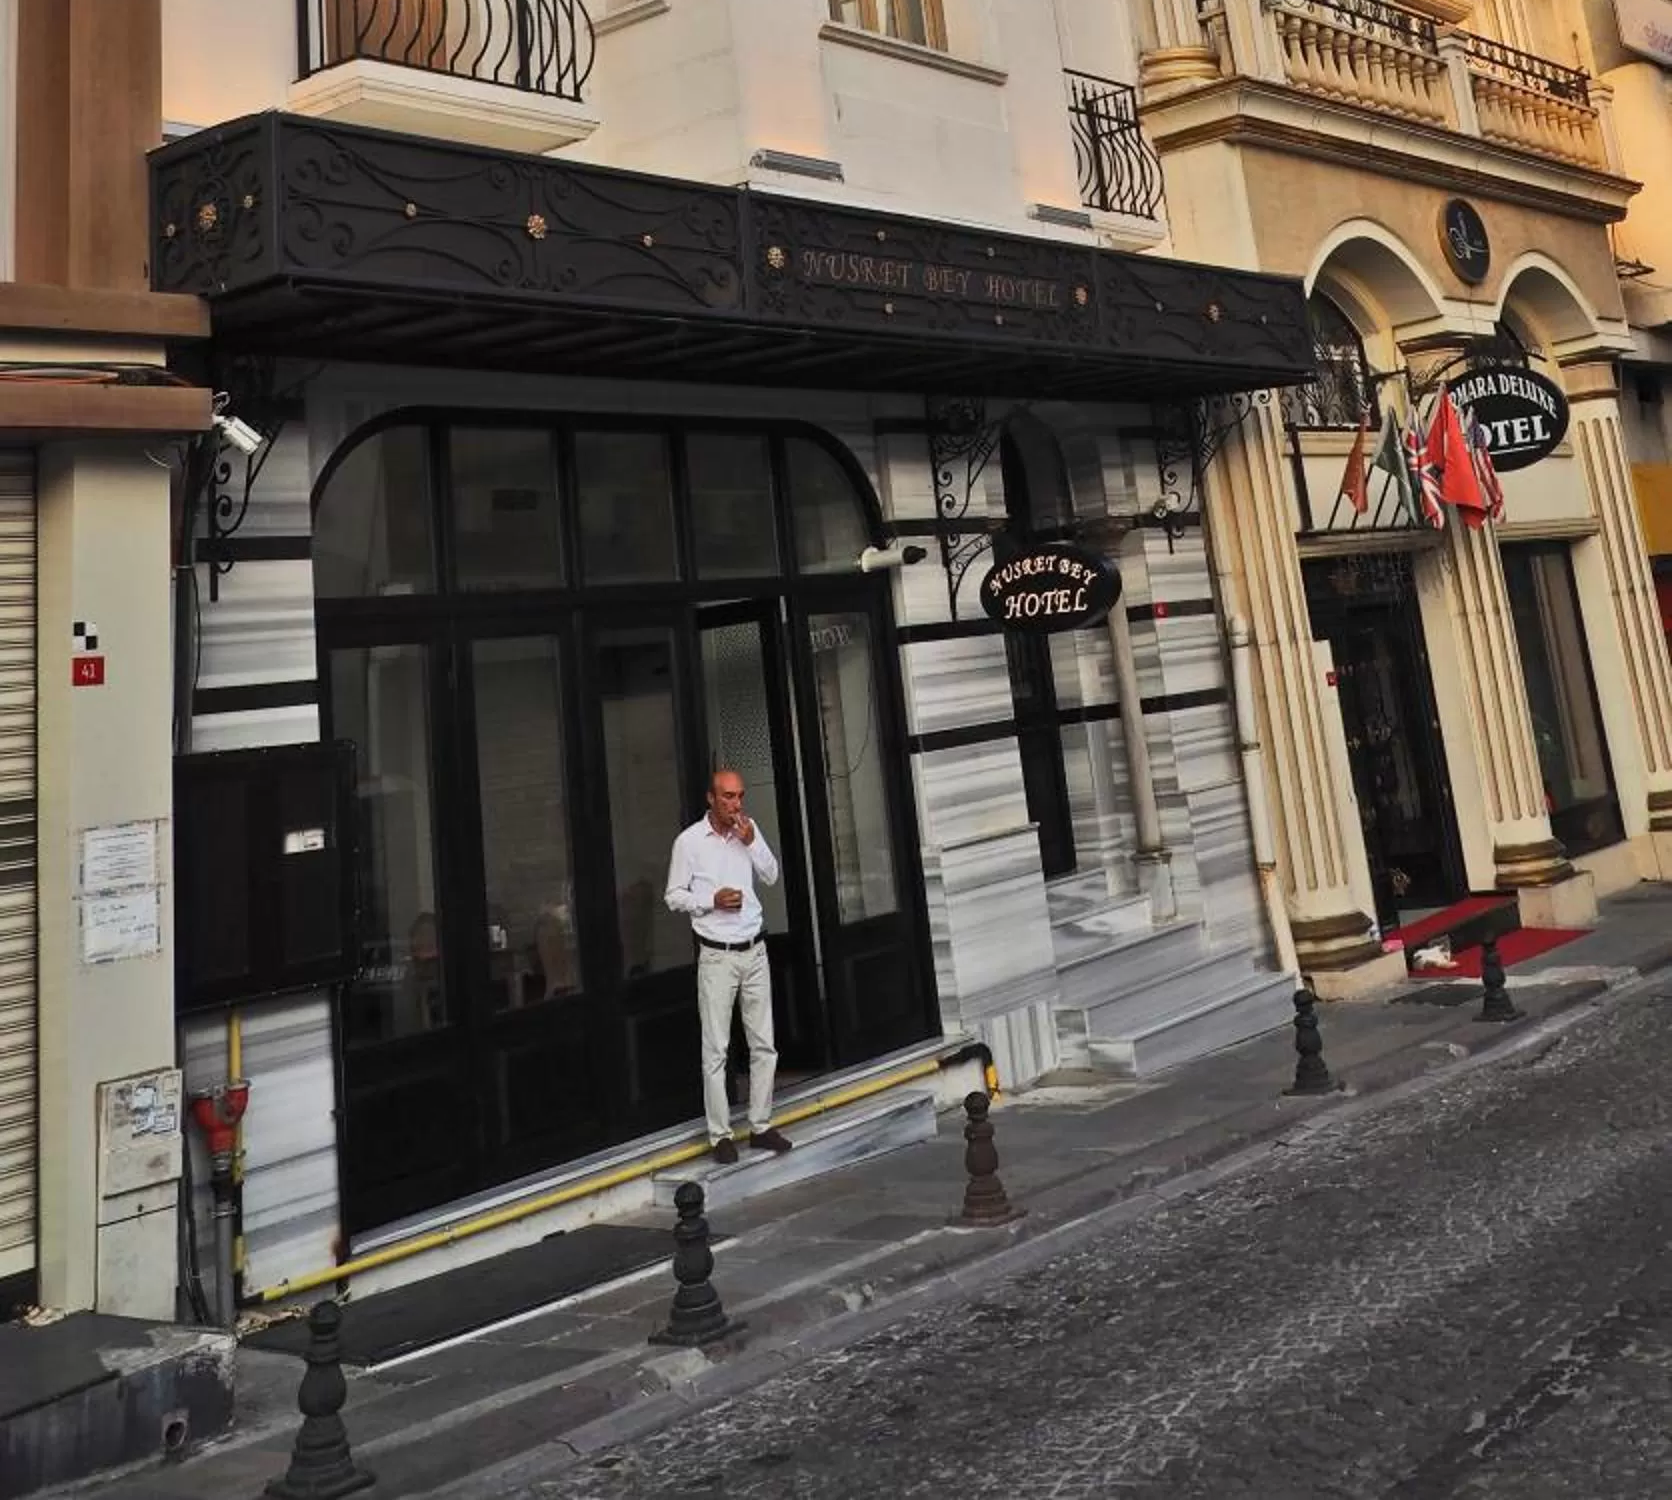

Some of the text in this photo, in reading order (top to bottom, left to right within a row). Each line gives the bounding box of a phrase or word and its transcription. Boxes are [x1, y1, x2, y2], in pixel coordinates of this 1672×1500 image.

[803, 250, 1061, 307] NUSRET BEY HOTEL
[1498, 373, 1559, 420] DELUXE
[989, 555, 1098, 597] NUSRET BEY
[1003, 587, 1089, 620] HOTEL
[81, 663, 97, 680] 41
